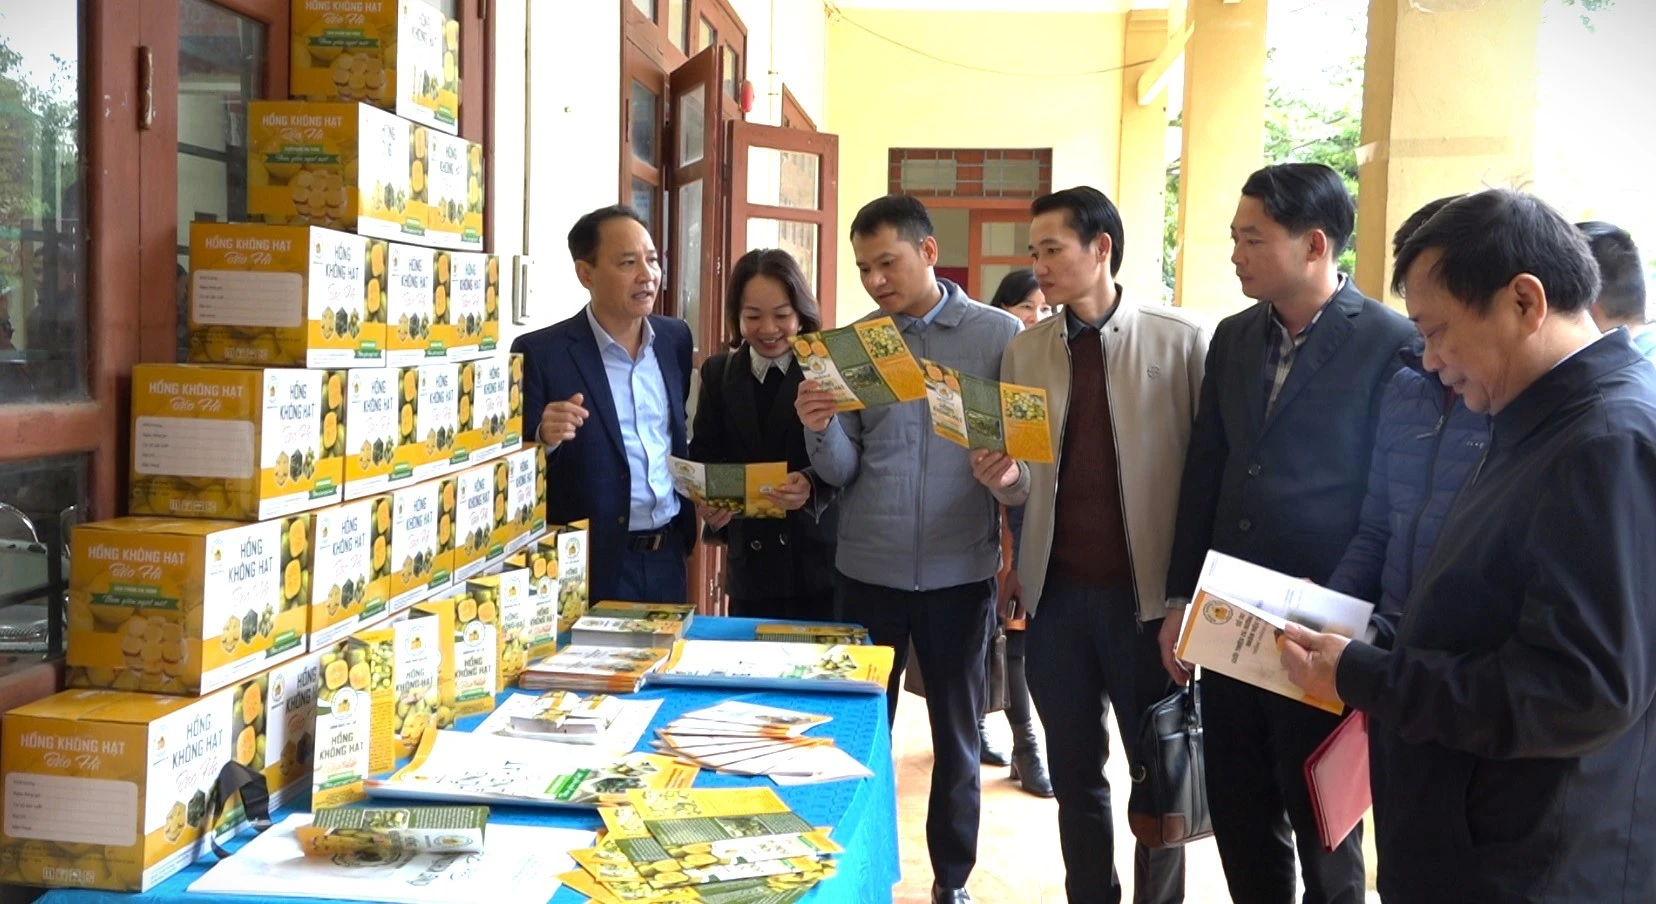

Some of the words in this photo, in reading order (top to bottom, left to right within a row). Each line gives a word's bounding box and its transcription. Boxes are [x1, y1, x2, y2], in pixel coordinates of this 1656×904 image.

[122, 547, 160, 563] KHÔNG
[163, 552, 186, 566] HẠT
[229, 560, 256, 583] KHÔNG
[57, 734, 98, 753] KHÔNG
[102, 741, 126, 756] HẠT
[172, 739, 204, 770] KHÔNG
[319, 746, 347, 761] KHÔNG
